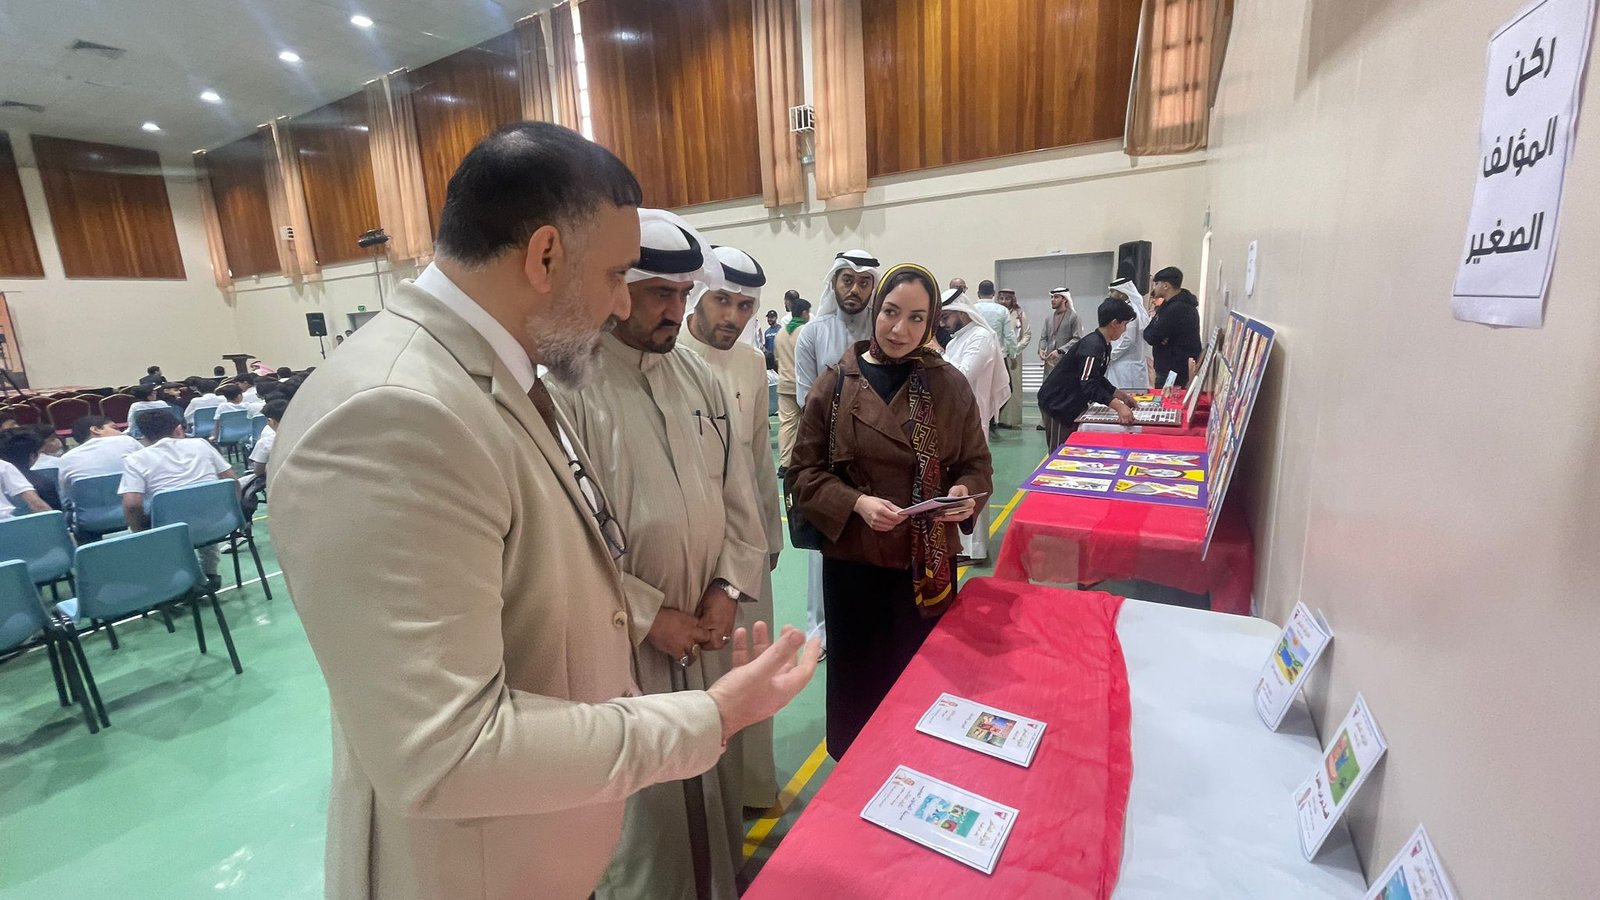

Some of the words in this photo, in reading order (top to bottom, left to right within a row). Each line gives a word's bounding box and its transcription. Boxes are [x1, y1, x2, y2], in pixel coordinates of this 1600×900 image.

[1505, 36, 1556, 96] ركن
[1484, 116, 1558, 177] المؤلف
[1466, 212, 1544, 264] الصغير
